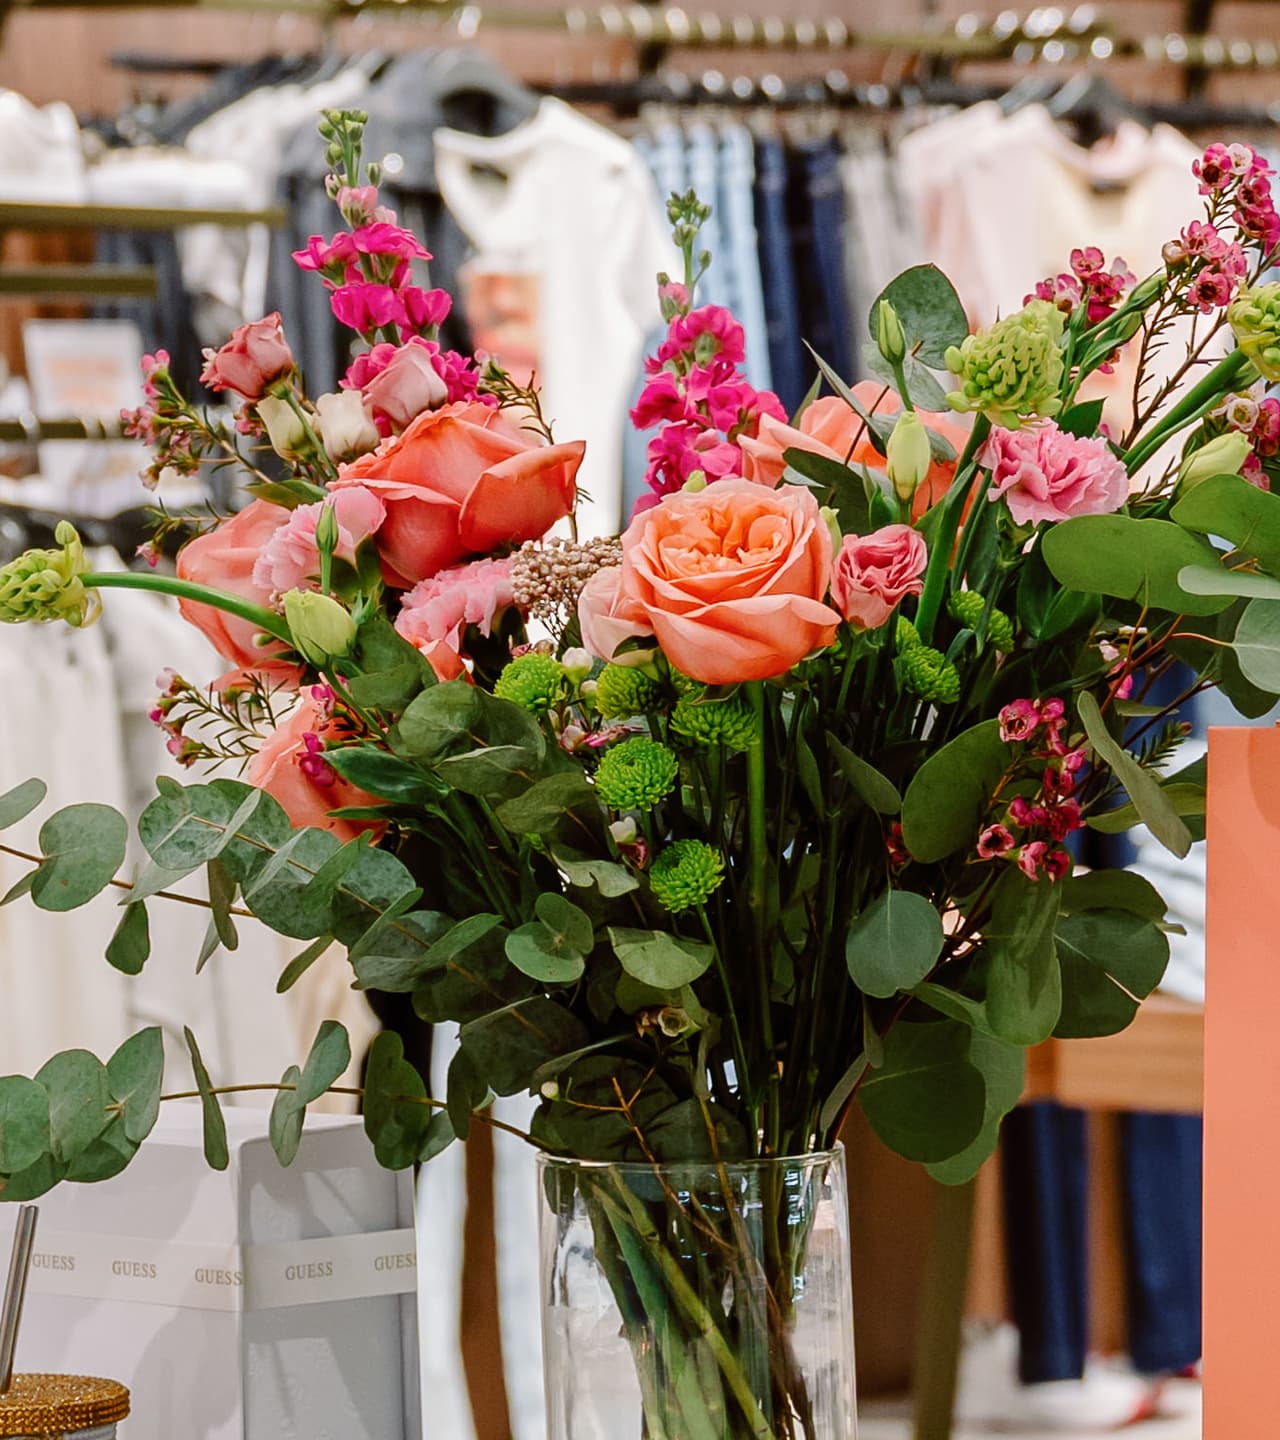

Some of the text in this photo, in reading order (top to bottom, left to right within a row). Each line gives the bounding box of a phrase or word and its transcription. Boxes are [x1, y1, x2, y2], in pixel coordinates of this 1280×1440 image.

[32, 1253, 76, 1271] GUESS
[111, 1260, 157, 1279] GUESS
[194, 1268, 243, 1286] GUESS
[284, 1261, 334, 1281] GUESS
